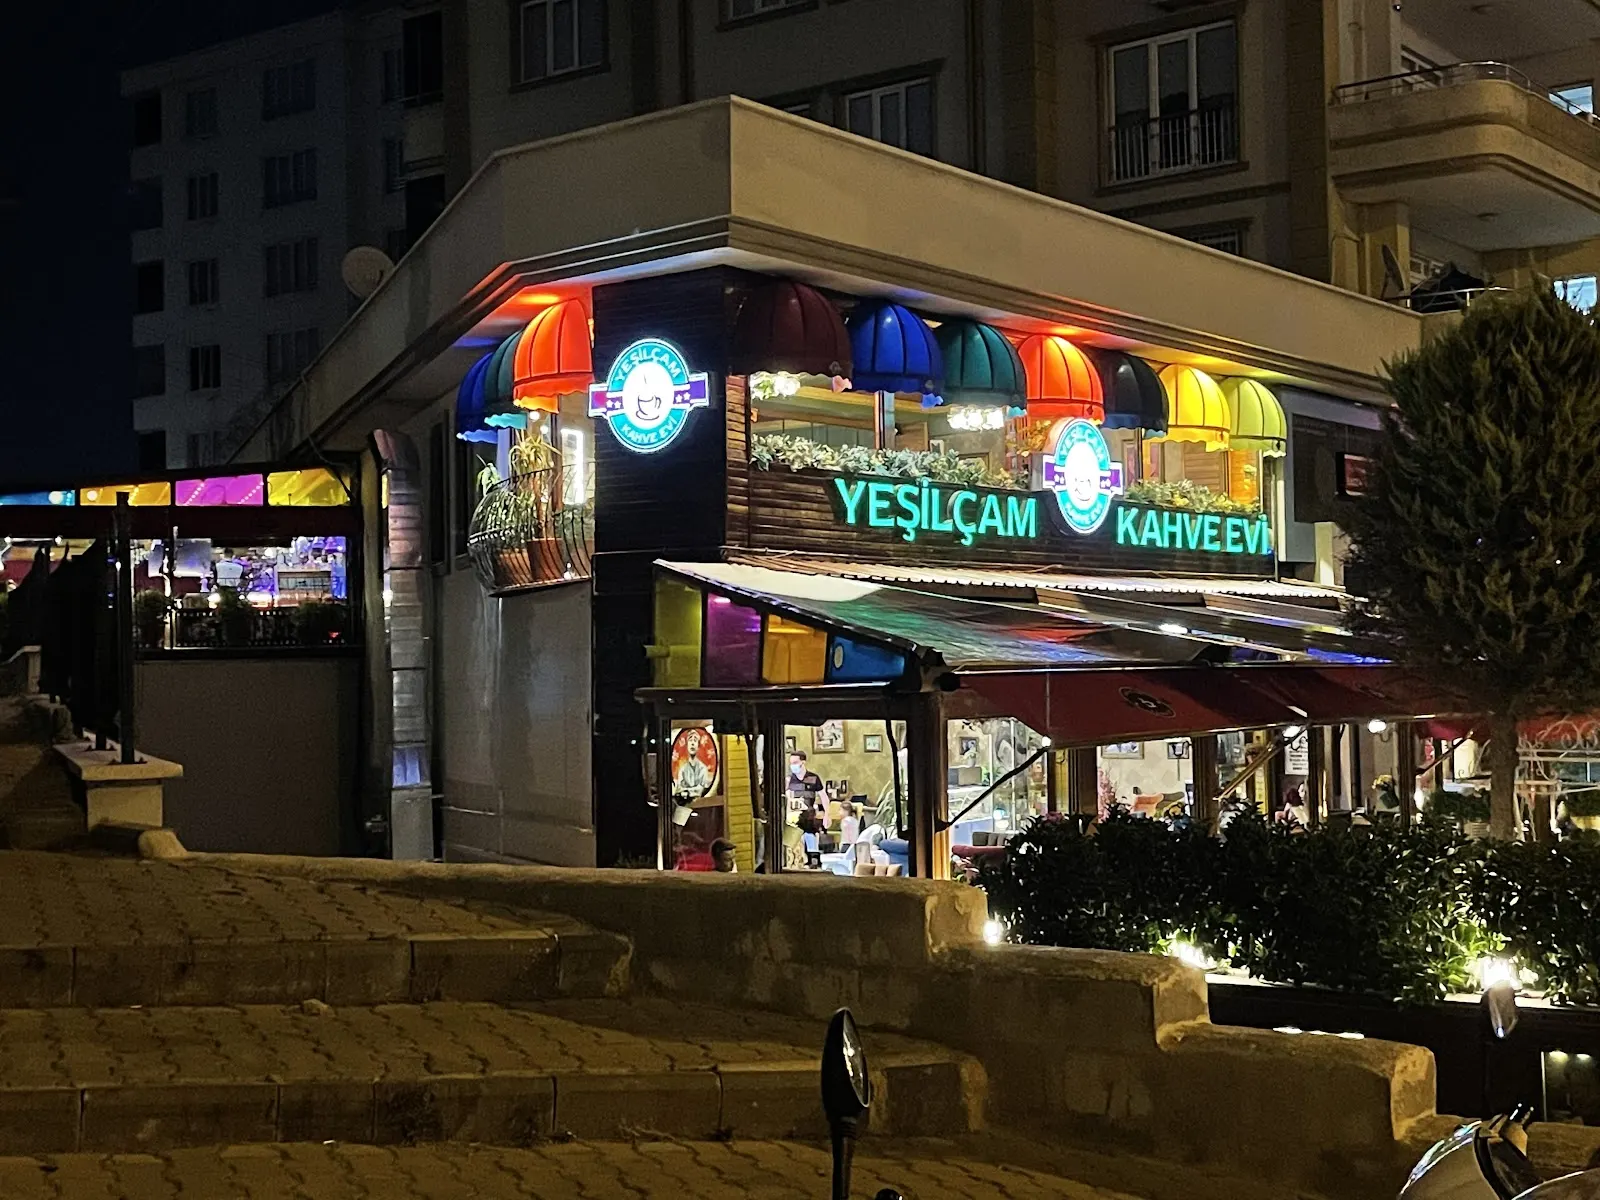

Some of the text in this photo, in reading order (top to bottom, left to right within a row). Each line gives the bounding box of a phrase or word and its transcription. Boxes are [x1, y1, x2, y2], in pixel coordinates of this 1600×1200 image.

[621, 423, 659, 444] KAHVE
[834, 477, 1269, 555] YEŞİLÇAM KAHVE EVİ
